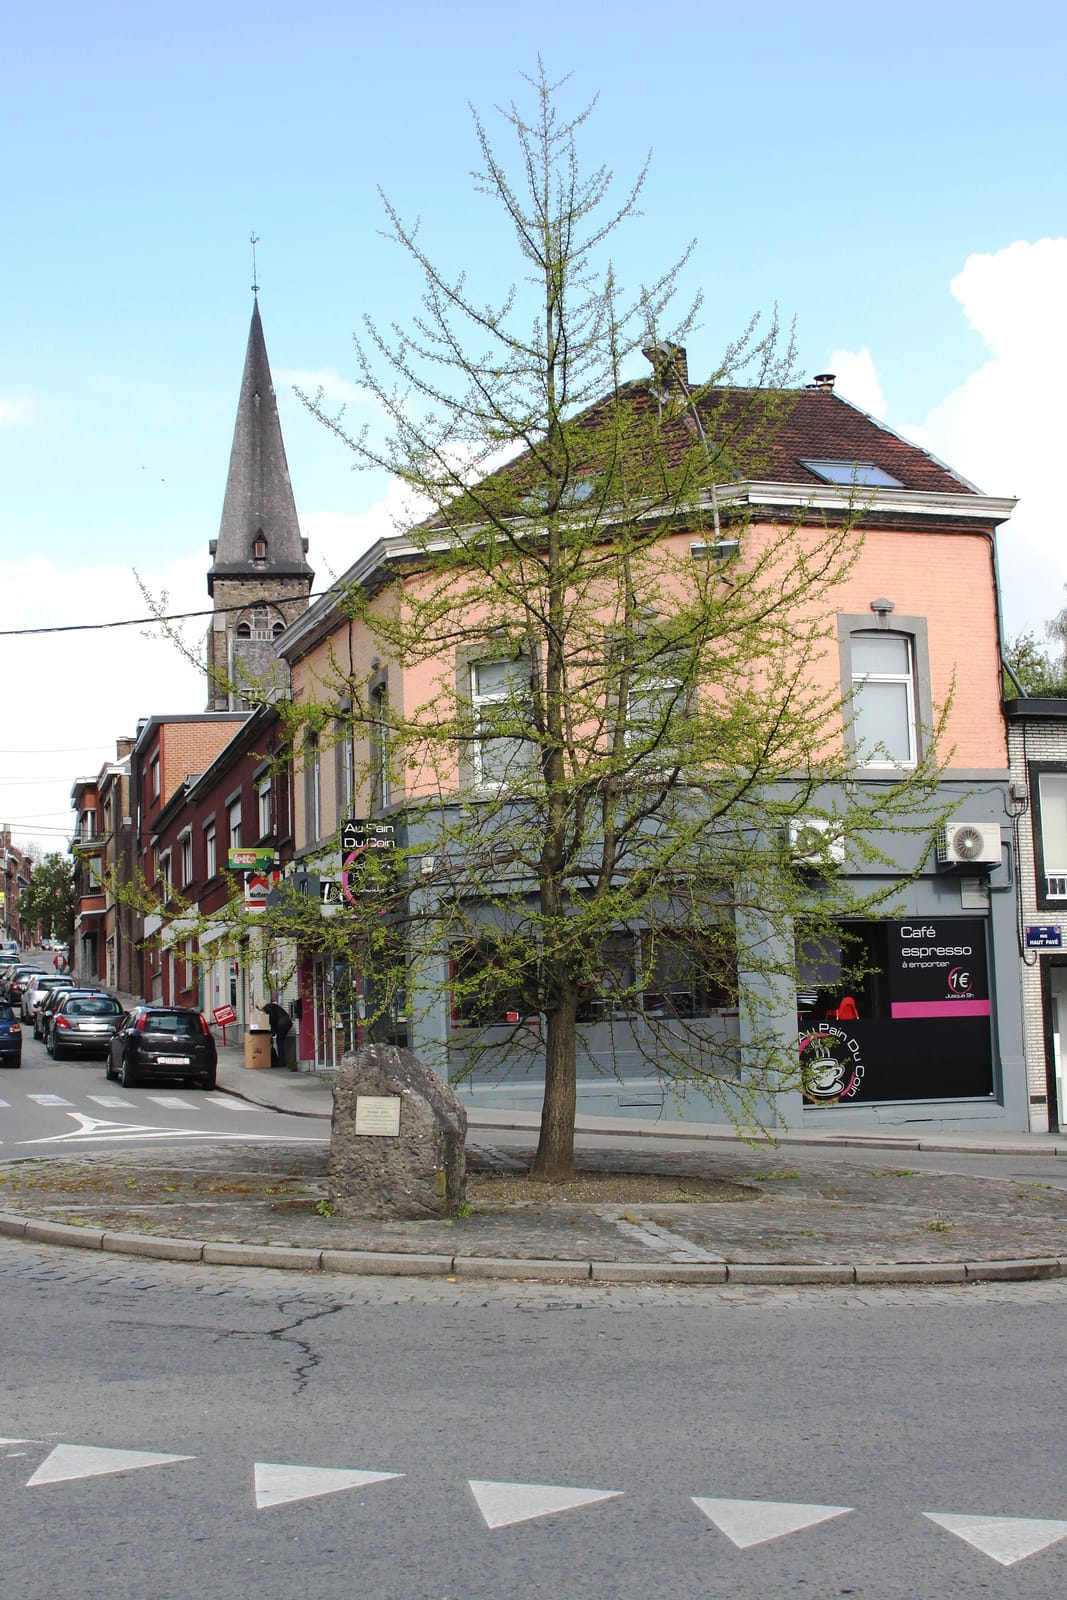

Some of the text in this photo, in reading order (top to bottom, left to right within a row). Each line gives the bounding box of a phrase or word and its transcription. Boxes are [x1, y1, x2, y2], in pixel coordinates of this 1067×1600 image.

[344, 823, 394, 833] Au Pain
[344, 837, 395, 848] Du Coin
[900, 926, 936, 938] Café
[901, 946, 972, 958] espresso
[951, 972, 970, 988] 1€
[819, 1023, 848, 1041] Pain
[847, 1038, 861, 1062] Du
[847, 1065, 865, 1097] Coin
